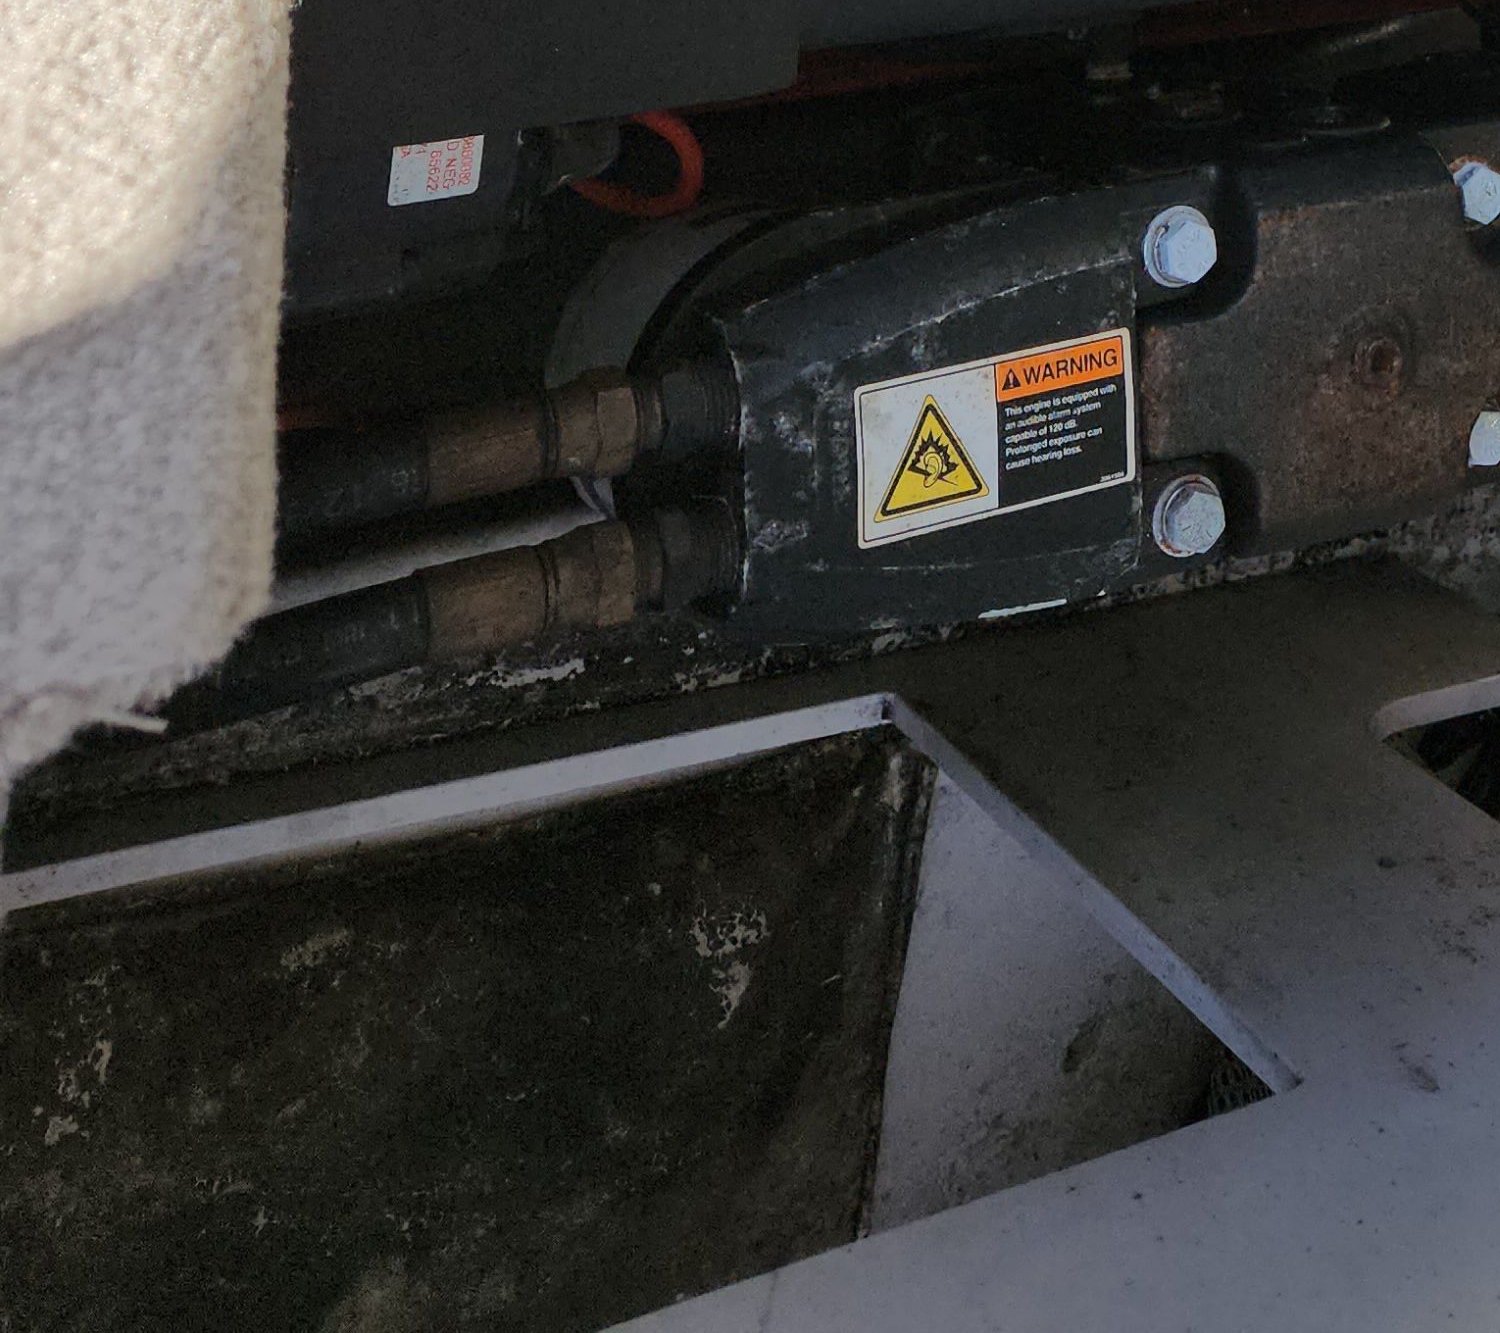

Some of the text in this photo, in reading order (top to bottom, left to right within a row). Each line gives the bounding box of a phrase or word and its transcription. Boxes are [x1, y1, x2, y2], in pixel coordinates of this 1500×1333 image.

[443, 158, 456, 190] NEG
[1023, 348, 1117, 386] WARNING
[1005, 383, 1117, 418] This engine is equipped with
[1005, 401, 1101, 431] an audible alarm system
[1005, 429, 1037, 444] capable
[1038, 425, 1048, 436] of
[1049, 422, 1063, 433] 120
[1005, 427, 1102, 457] Prolonged exposure can
[1005, 444, 1082, 471] cause hearing loss.
